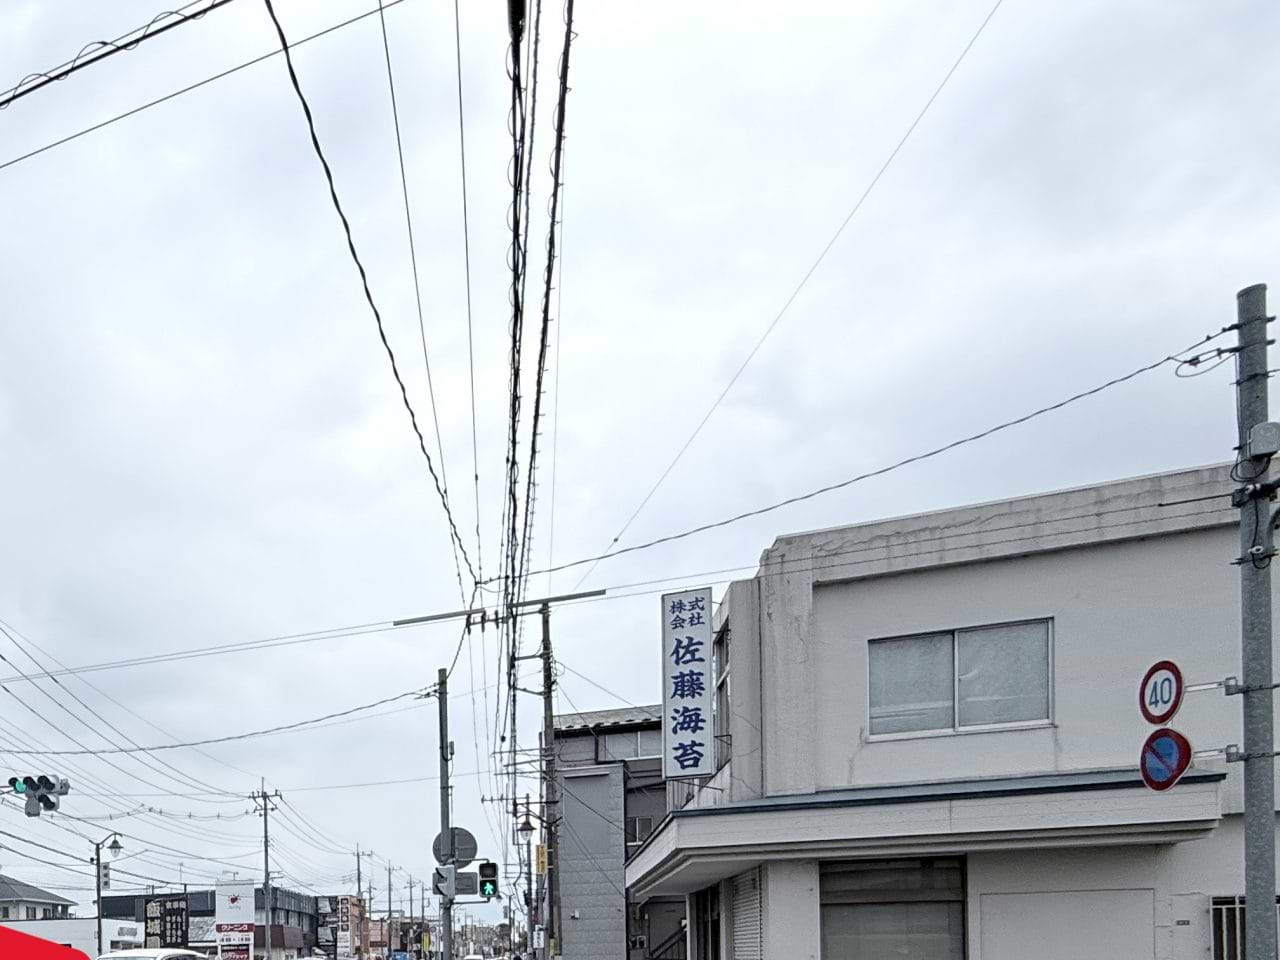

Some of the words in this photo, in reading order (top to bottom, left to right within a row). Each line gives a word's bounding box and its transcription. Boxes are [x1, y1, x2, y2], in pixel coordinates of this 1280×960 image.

[670, 636, 706, 770] 佐藤海苔
[1149, 677, 1172, 708] 40
